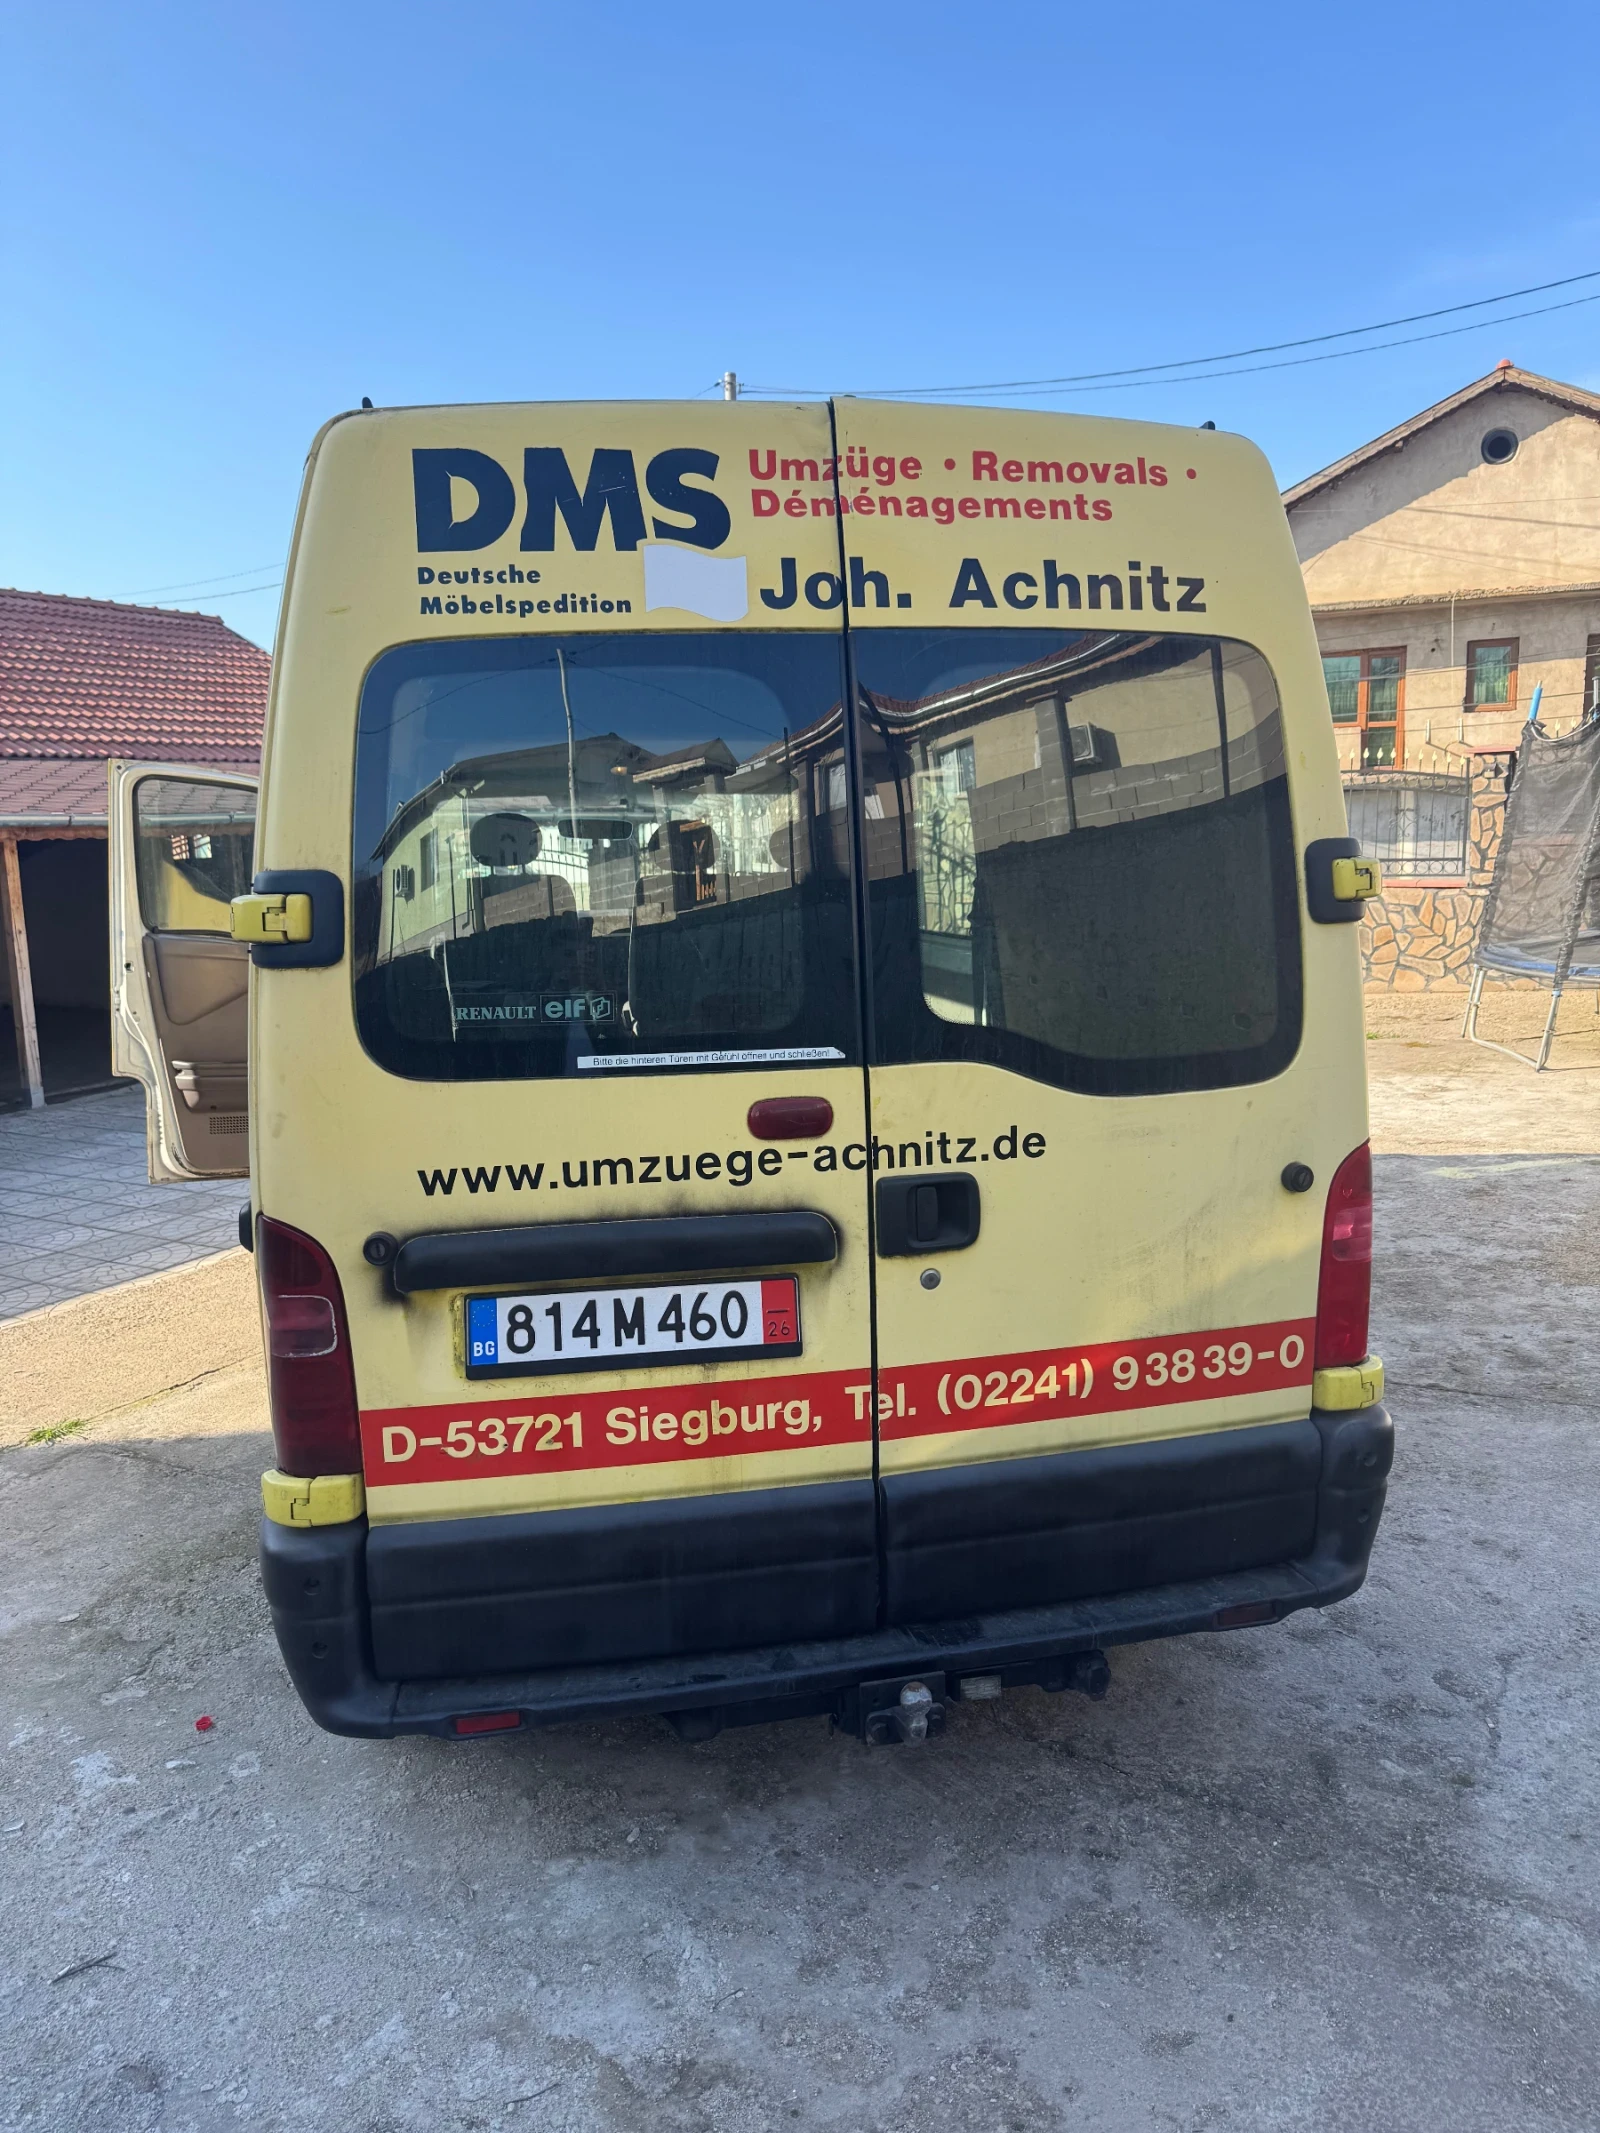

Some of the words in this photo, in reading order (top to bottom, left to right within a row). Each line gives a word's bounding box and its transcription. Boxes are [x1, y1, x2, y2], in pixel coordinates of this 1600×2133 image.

[748, 446, 923, 486] Umzüge
[971, 449, 1168, 487] Removals
[412, 447, 731, 553] DMS
[751, 487, 1114, 525] Déménagements
[417, 564, 541, 585] Deutsche
[760, 556, 911, 610] Joh.
[949, 557, 1207, 613] Achnitz
[420, 593, 632, 617] Möbelspedition
[455, 1006, 537, 1020] RENAULT
[544, 998, 586, 1019] elf
[593, 1057, 613, 1066] Bitte
[615, 1057, 629, 1065] die
[631, 1055, 667, 1064] hinteren
[669, 1053, 694, 1063] Türen
[696, 1052, 709, 1062] mit
[769, 1050, 786, 1059] und
[787, 1048, 830, 1059] schleßen!
[418, 1125, 1047, 1197] www.umzuege-achnitz.de
[473, 1341, 495, 1357] BG
[768, 1319, 790, 1337] 26
[382, 1411, 584, 1464] D-53721
[605, 1397, 822, 1446] Siegburg,
[844, 1383, 917, 1421] Tel.
[937, 1358, 1094, 1415] (02241)
